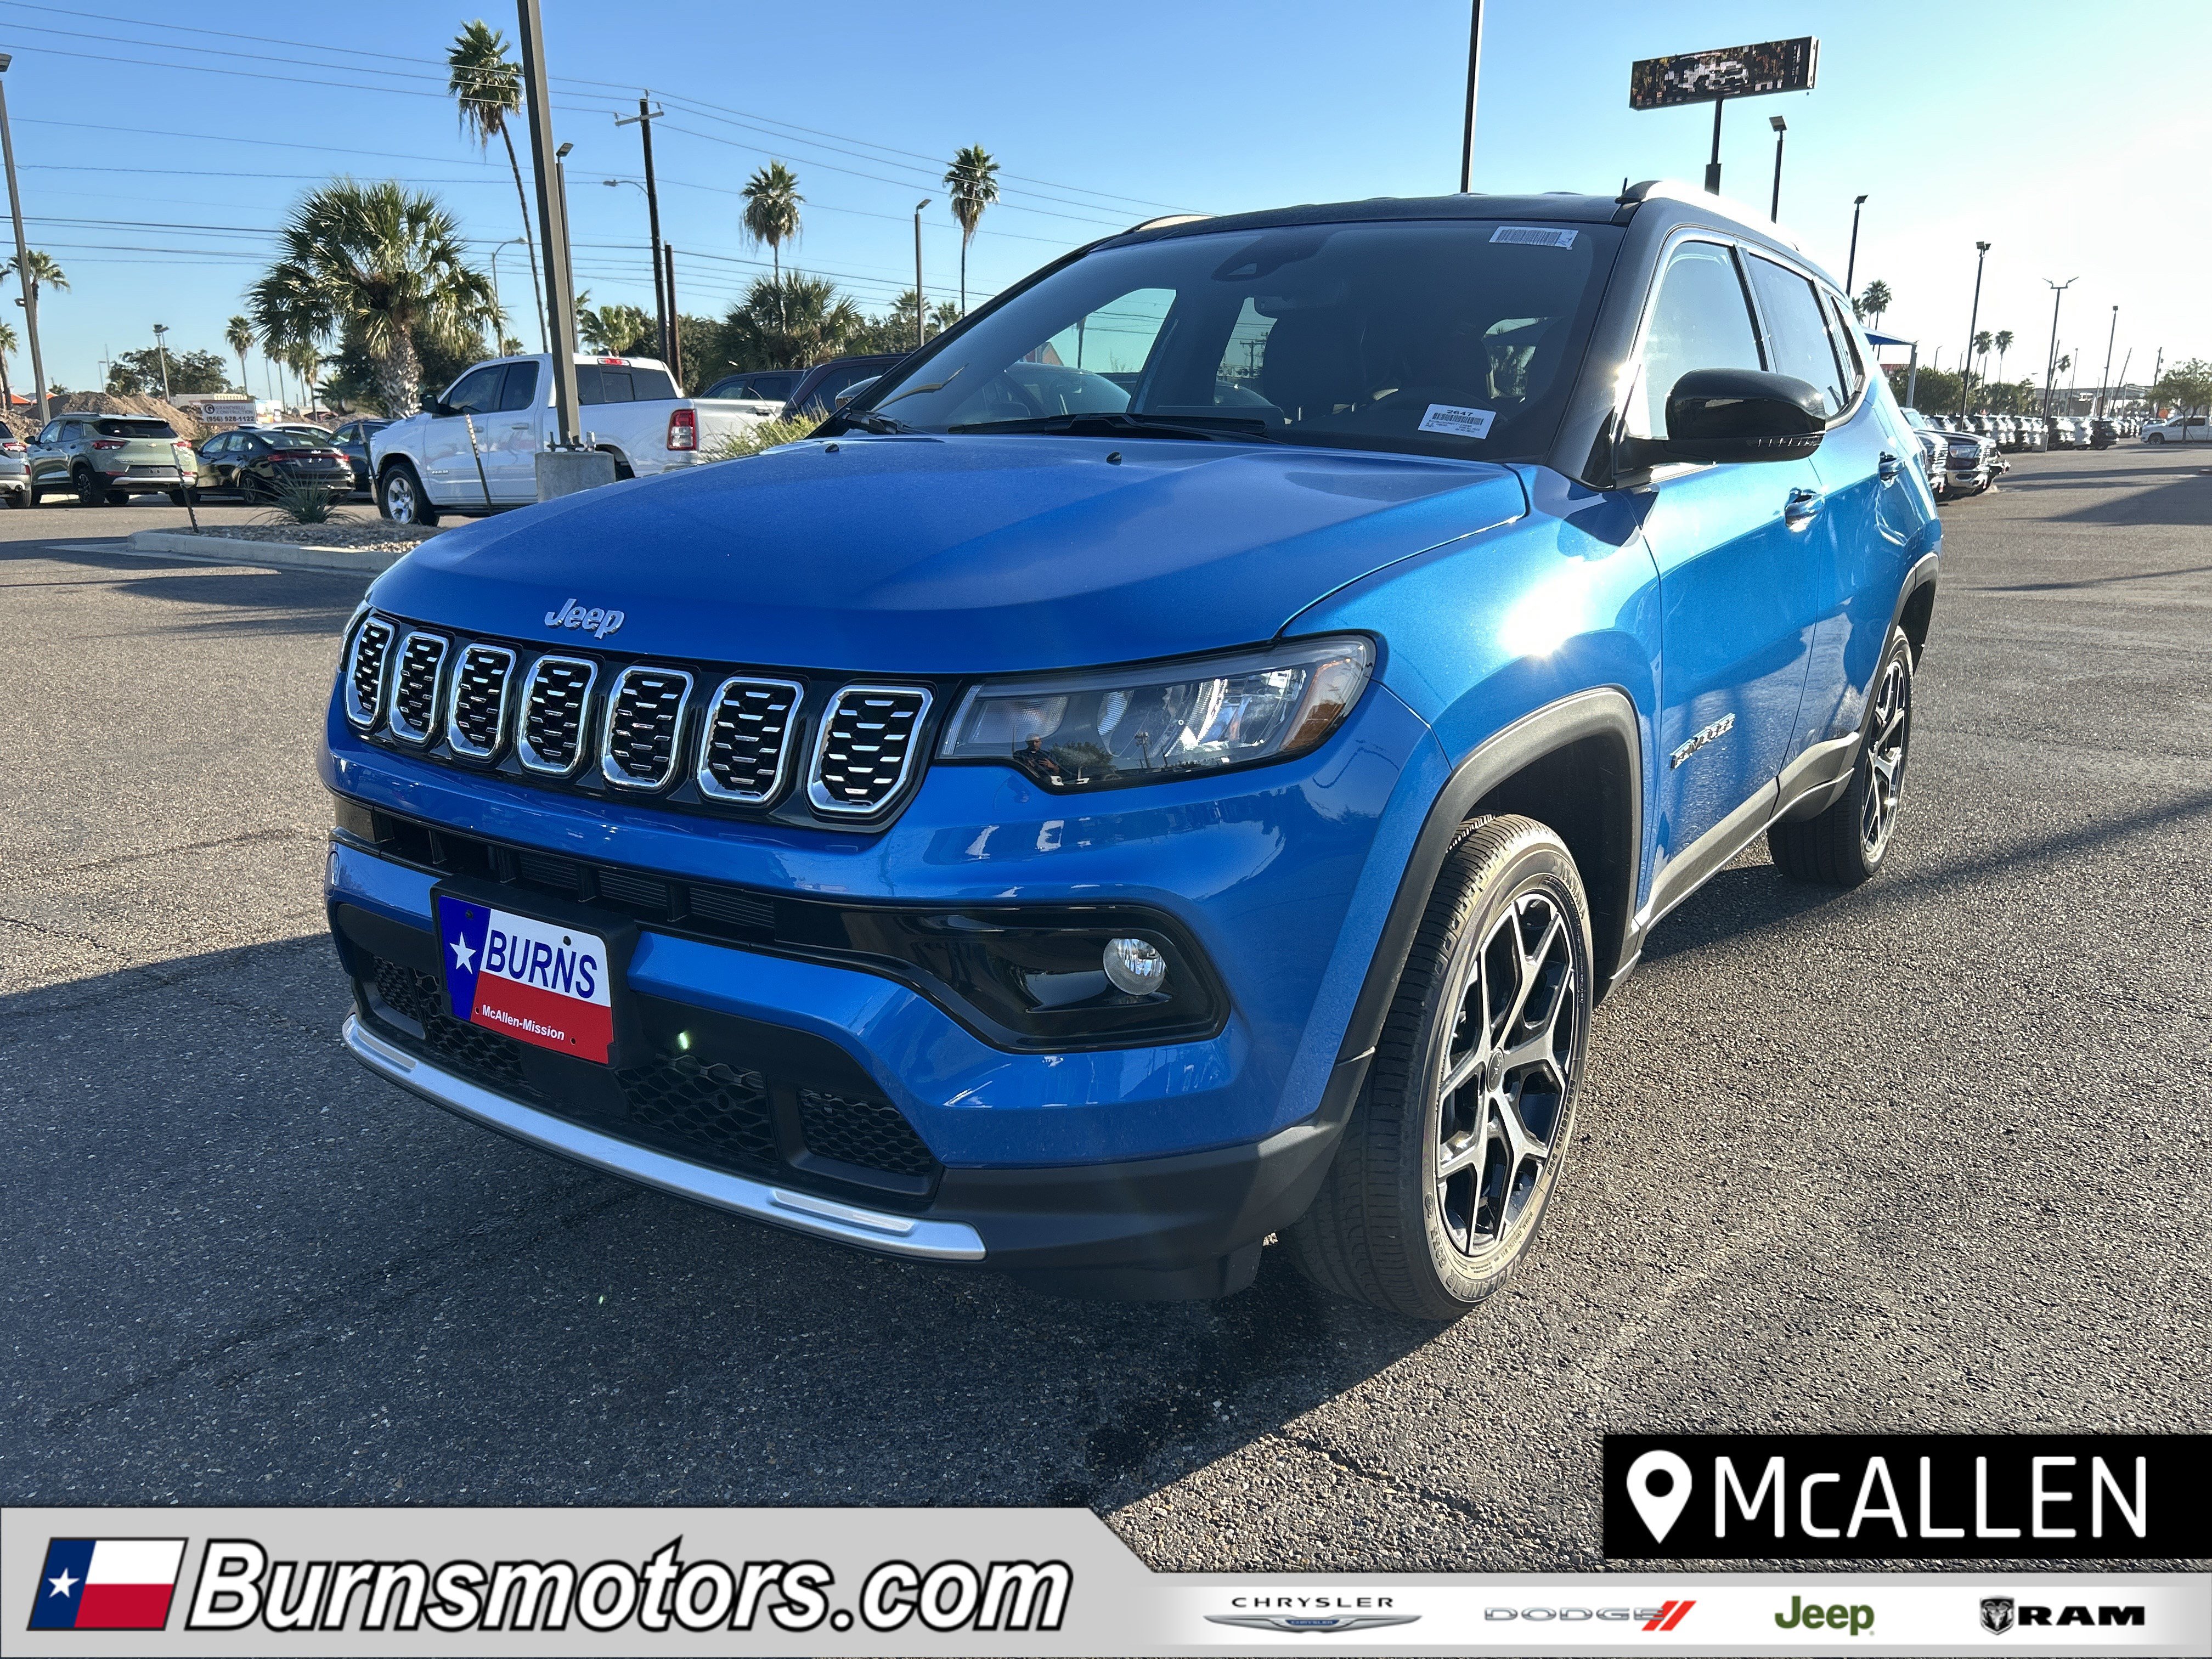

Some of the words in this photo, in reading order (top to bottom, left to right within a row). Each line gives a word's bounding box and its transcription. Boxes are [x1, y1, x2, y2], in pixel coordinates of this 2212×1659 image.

[544, 598, 625, 639] Jeep
[486, 929, 597, 998] BURNS
[482, 1004, 565, 1041] McAllen-Mission
